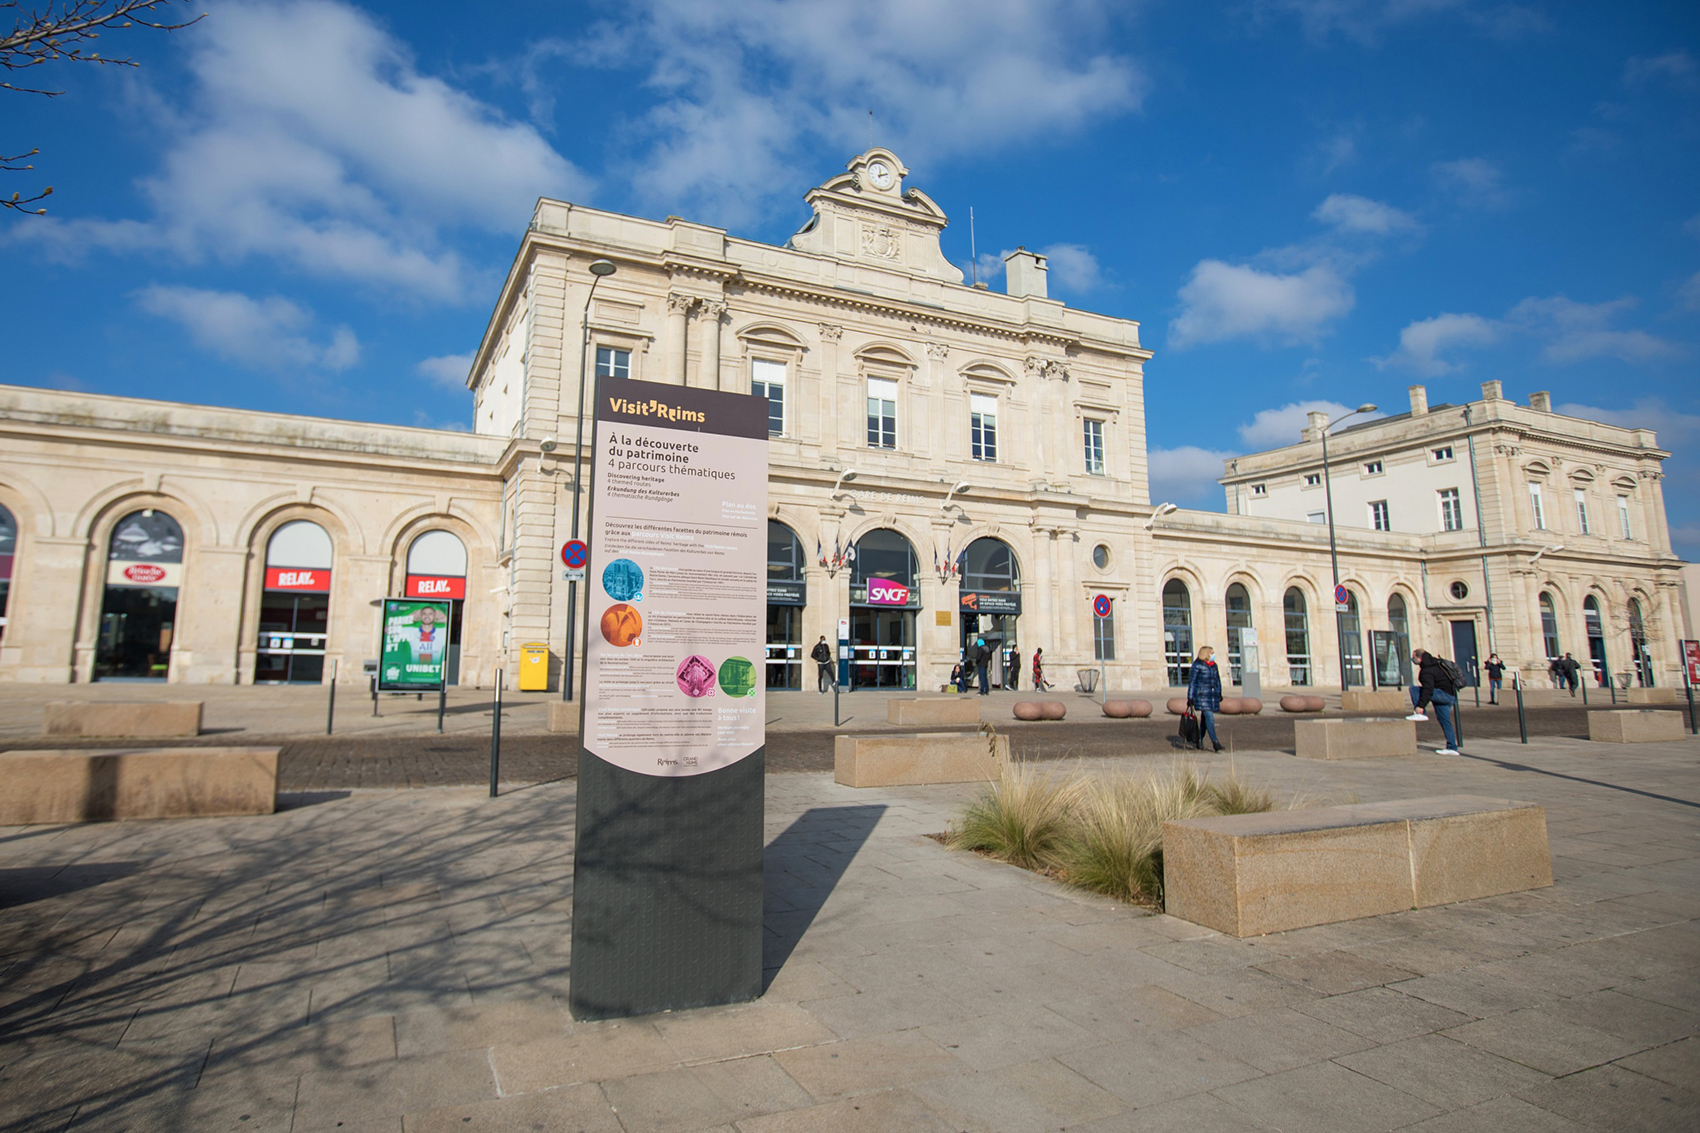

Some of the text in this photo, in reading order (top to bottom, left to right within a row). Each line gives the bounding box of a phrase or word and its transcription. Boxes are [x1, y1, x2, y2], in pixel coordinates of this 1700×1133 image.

[609, 432, 699, 453] À la découverte
[609, 446, 689, 463] du patrimoine
[608, 458, 736, 480] 4 parcours thématiques
[607, 473, 665, 483] Discovering heritage
[607, 486, 637, 494] Erkundung
[612, 492, 644, 500] thematische
[851, 489, 925, 505] GARE DE REIMS
[870, 588, 907, 601] SNCF
[406, 664, 441, 674] UNIBET
